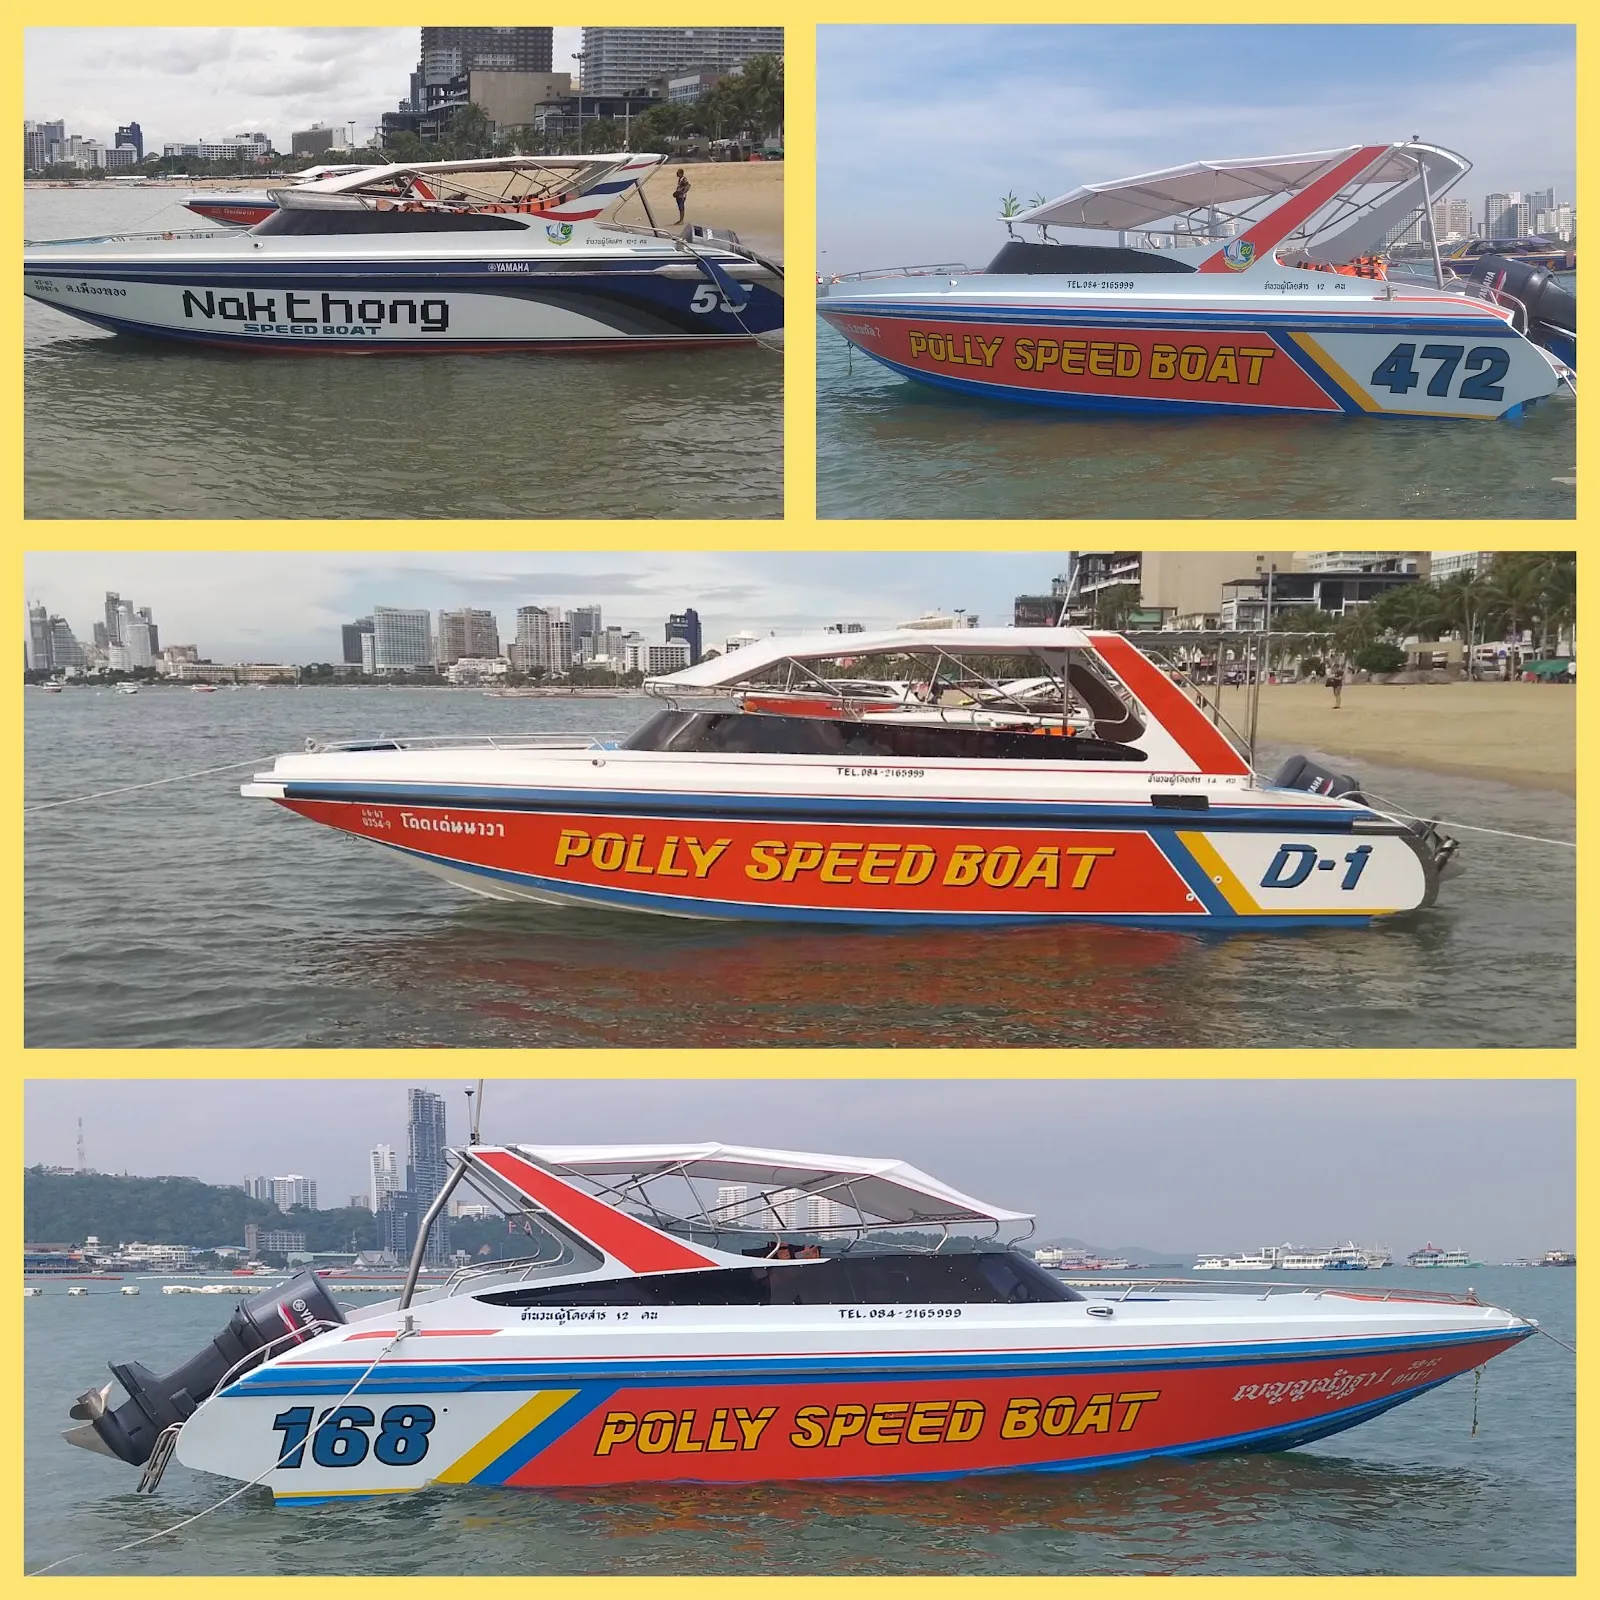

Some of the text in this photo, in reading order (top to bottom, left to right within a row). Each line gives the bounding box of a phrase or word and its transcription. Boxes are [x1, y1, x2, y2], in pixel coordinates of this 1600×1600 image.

[496, 262, 530, 272] YAMAHA
[1264, 280, 1309, 294] จำนวนผู้โดยสาร
[182, 289, 449, 332] Nakthong
[244, 323, 382, 335] SPEED BOAT
[908, 330, 1276, 386] POLLY SPEED BOAT
[1370, 343, 1511, 402] 472
[400, 812, 506, 838] โดดเด่นนาวา
[554, 828, 1116, 890] POLLY SPEED BOAT
[1259, 843, 1375, 890] D-1
[521, 1307, 658, 1325] จำนวนผู้โดยสาร 12 คน
[272, 1403, 436, 1469] 168
[593, 1389, 1162, 1457] POLLY SPEED BOAT
